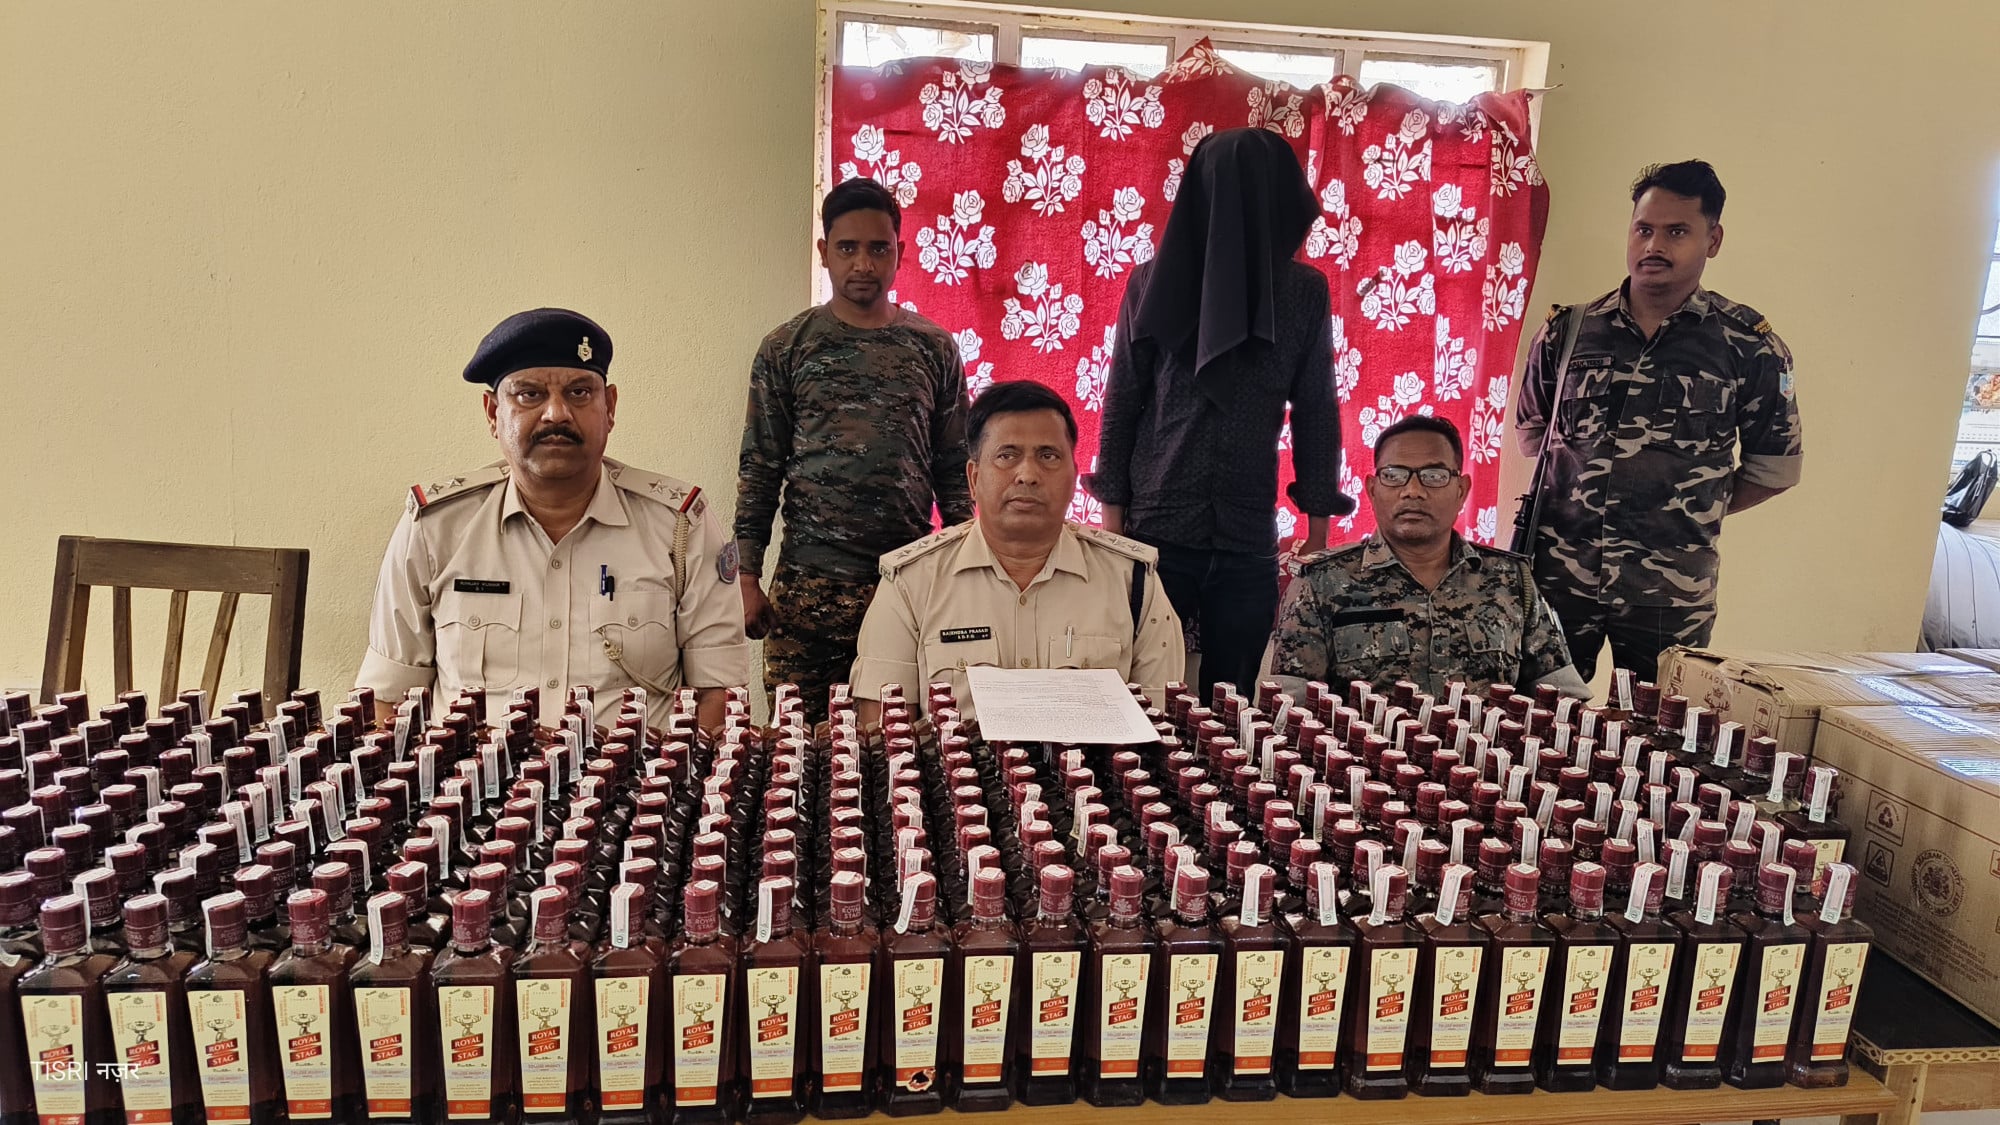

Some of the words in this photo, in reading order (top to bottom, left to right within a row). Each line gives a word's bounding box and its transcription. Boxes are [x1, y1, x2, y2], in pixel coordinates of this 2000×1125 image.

[1311, 992, 1333, 1002] ROYAL
[1444, 992, 1466, 1002] ROYAL
[1510, 991, 1531, 1002] ROYAL
[1574, 990, 1595, 1000] ROYAL
[1635, 988, 1656, 999] ROYAL
[1701, 988, 1722, 997] ROYAL
[1768, 988, 1788, 998] ROYAL
[1830, 987, 1849, 997] ROYAL
[1043, 998, 1066, 1008] ROYAL
[1246, 996, 1268, 1008] ROYAL
[1380, 994, 1401, 1004] ROYAL
[1635, 999, 1653, 1008] STAG
[1701, 999, 1718, 1008] STAG
[1830, 998, 1846, 1008] STAG
[975, 1002, 998, 1014] ROYAL
[1112, 1000, 1134, 1012] ROYAL
[1179, 1000, 1202, 1010] ROYAL
[1312, 1004, 1330, 1014] STAG
[1445, 1004, 1463, 1014] STAG
[1511, 1003, 1528, 1012] STAG
[1574, 1002, 1592, 1011] STAG
[1768, 1001, 1785, 1009] STAG
[906, 1006, 929, 1017] ROYAL
[1044, 1010, 1063, 1020] STAG
[1248, 1010, 1266, 1019] STAG
[1381, 1006, 1399, 1016] STAG
[761, 1015, 784, 1027] ROYAL
[833, 1011, 856, 1022] ROYAL
[977, 1015, 996, 1026] STAG
[1114, 1014, 1132, 1022] STAG
[1181, 1012, 1199, 1022] STAG
[835, 1023, 854, 1033] STAG
[908, 1018, 927, 1028] STAG
[532, 1029, 556, 1040] ROYAL
[610, 1026, 634, 1038] ROYAL
[686, 1024, 710, 1035] ROYAL
[763, 1030, 783, 1039] STAG
[292, 1035, 317, 1047] ROYAL
[373, 1036, 398, 1047] ROYAL
[454, 1036, 480, 1047] ROYAL
[613, 1040, 633, 1050] STAG
[688, 1038, 708, 1046] STAG
[129, 1043, 156, 1055] ROYAL
[208, 1041, 234, 1052] ROYAL
[534, 1044, 555, 1053] STAG
[295, 1049, 317, 1059] STAG
[376, 1050, 397, 1059] STAG
[457, 1051, 478, 1060] STAG
[212, 1054, 234, 1065] STAG
